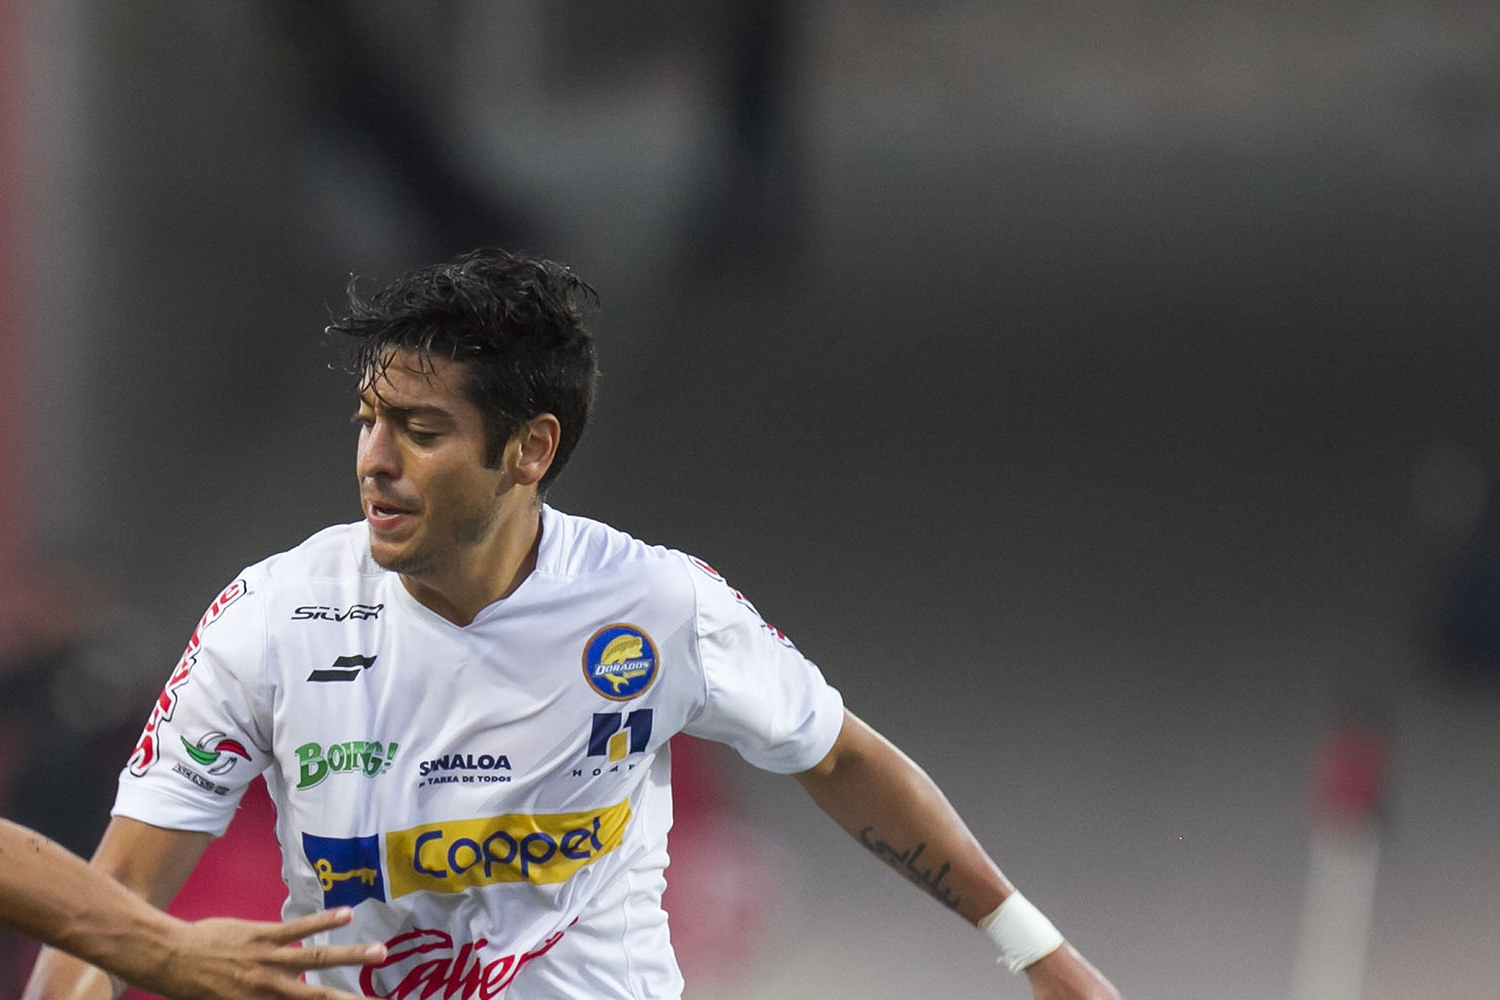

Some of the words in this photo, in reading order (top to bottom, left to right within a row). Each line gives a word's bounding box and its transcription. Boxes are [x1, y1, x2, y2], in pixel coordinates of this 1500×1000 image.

[595, 661, 650, 676] DORADOS
[294, 740, 400, 789] BOING!
[419, 753, 512, 777] SINALOA
[428, 775, 460, 786] TAREA
[462, 775, 475, 783] DE
[478, 775, 512, 783] TODOS
[413, 816, 604, 879] Coppel
